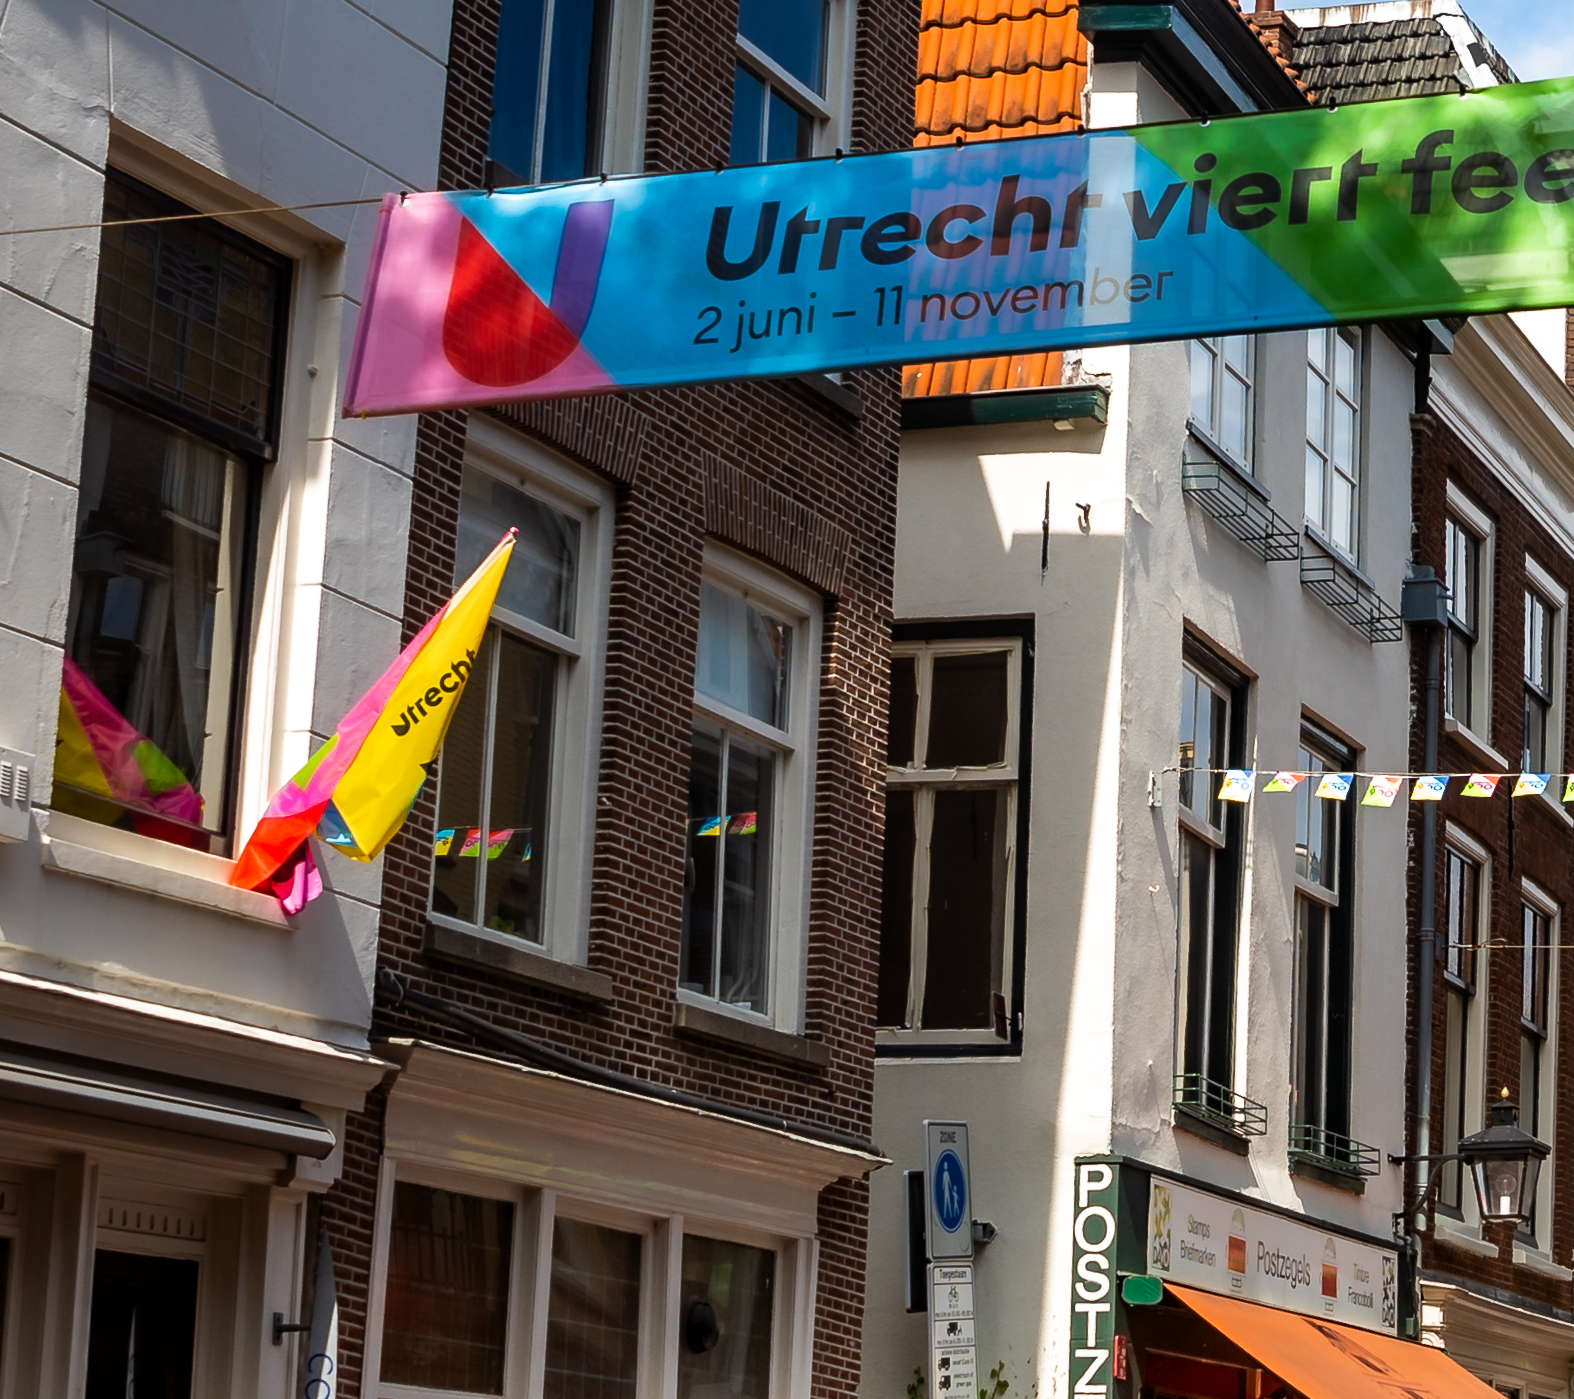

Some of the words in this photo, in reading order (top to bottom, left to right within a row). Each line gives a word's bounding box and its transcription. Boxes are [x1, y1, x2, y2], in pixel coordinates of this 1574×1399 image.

[703, 173, 1105, 282] Utrecht
[1122, 148, 1380, 242] viert
[692, 304, 722, 347] 2
[730, 293, 819, 354] juni
[873, 285, 905, 329] 11
[918, 262, 1175, 325] november
[939, 1130, 957, 1144] ZONE
[1186, 1213, 1211, 1239] Stamps
[1179, 1239, 1217, 1269] Briefmarken
[1256, 1240, 1312, 1289] Postzegels
[1352, 1262, 1370, 1284] Timbre
[1347, 1285, 1374, 1309] Francobolli
